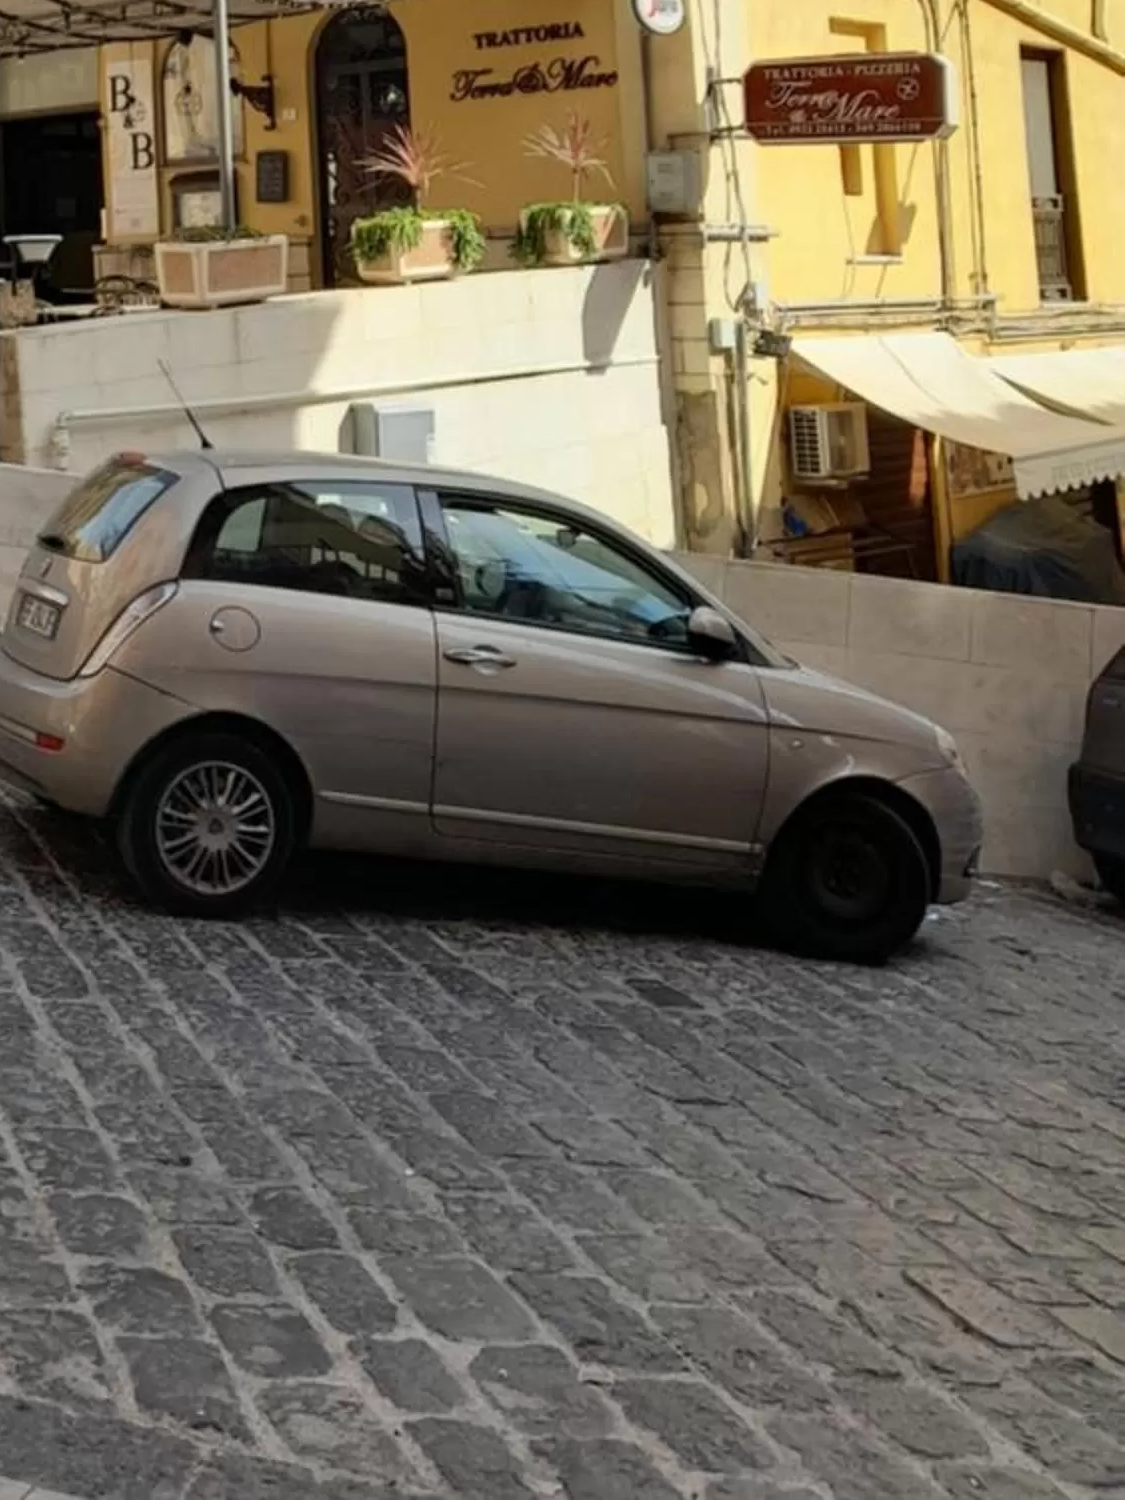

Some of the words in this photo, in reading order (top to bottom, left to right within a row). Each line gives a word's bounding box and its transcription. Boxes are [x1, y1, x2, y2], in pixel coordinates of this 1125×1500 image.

[472, 20, 585, 50] TRATTORIA
[546, 55, 619, 93] Mare
[764, 64, 844, 80] TRATTORIA
[854, 61, 921, 76] PIZZERIA
[110, 74, 133, 112] B
[131, 131, 154, 170] B
[812, 89, 900, 123] Mare
